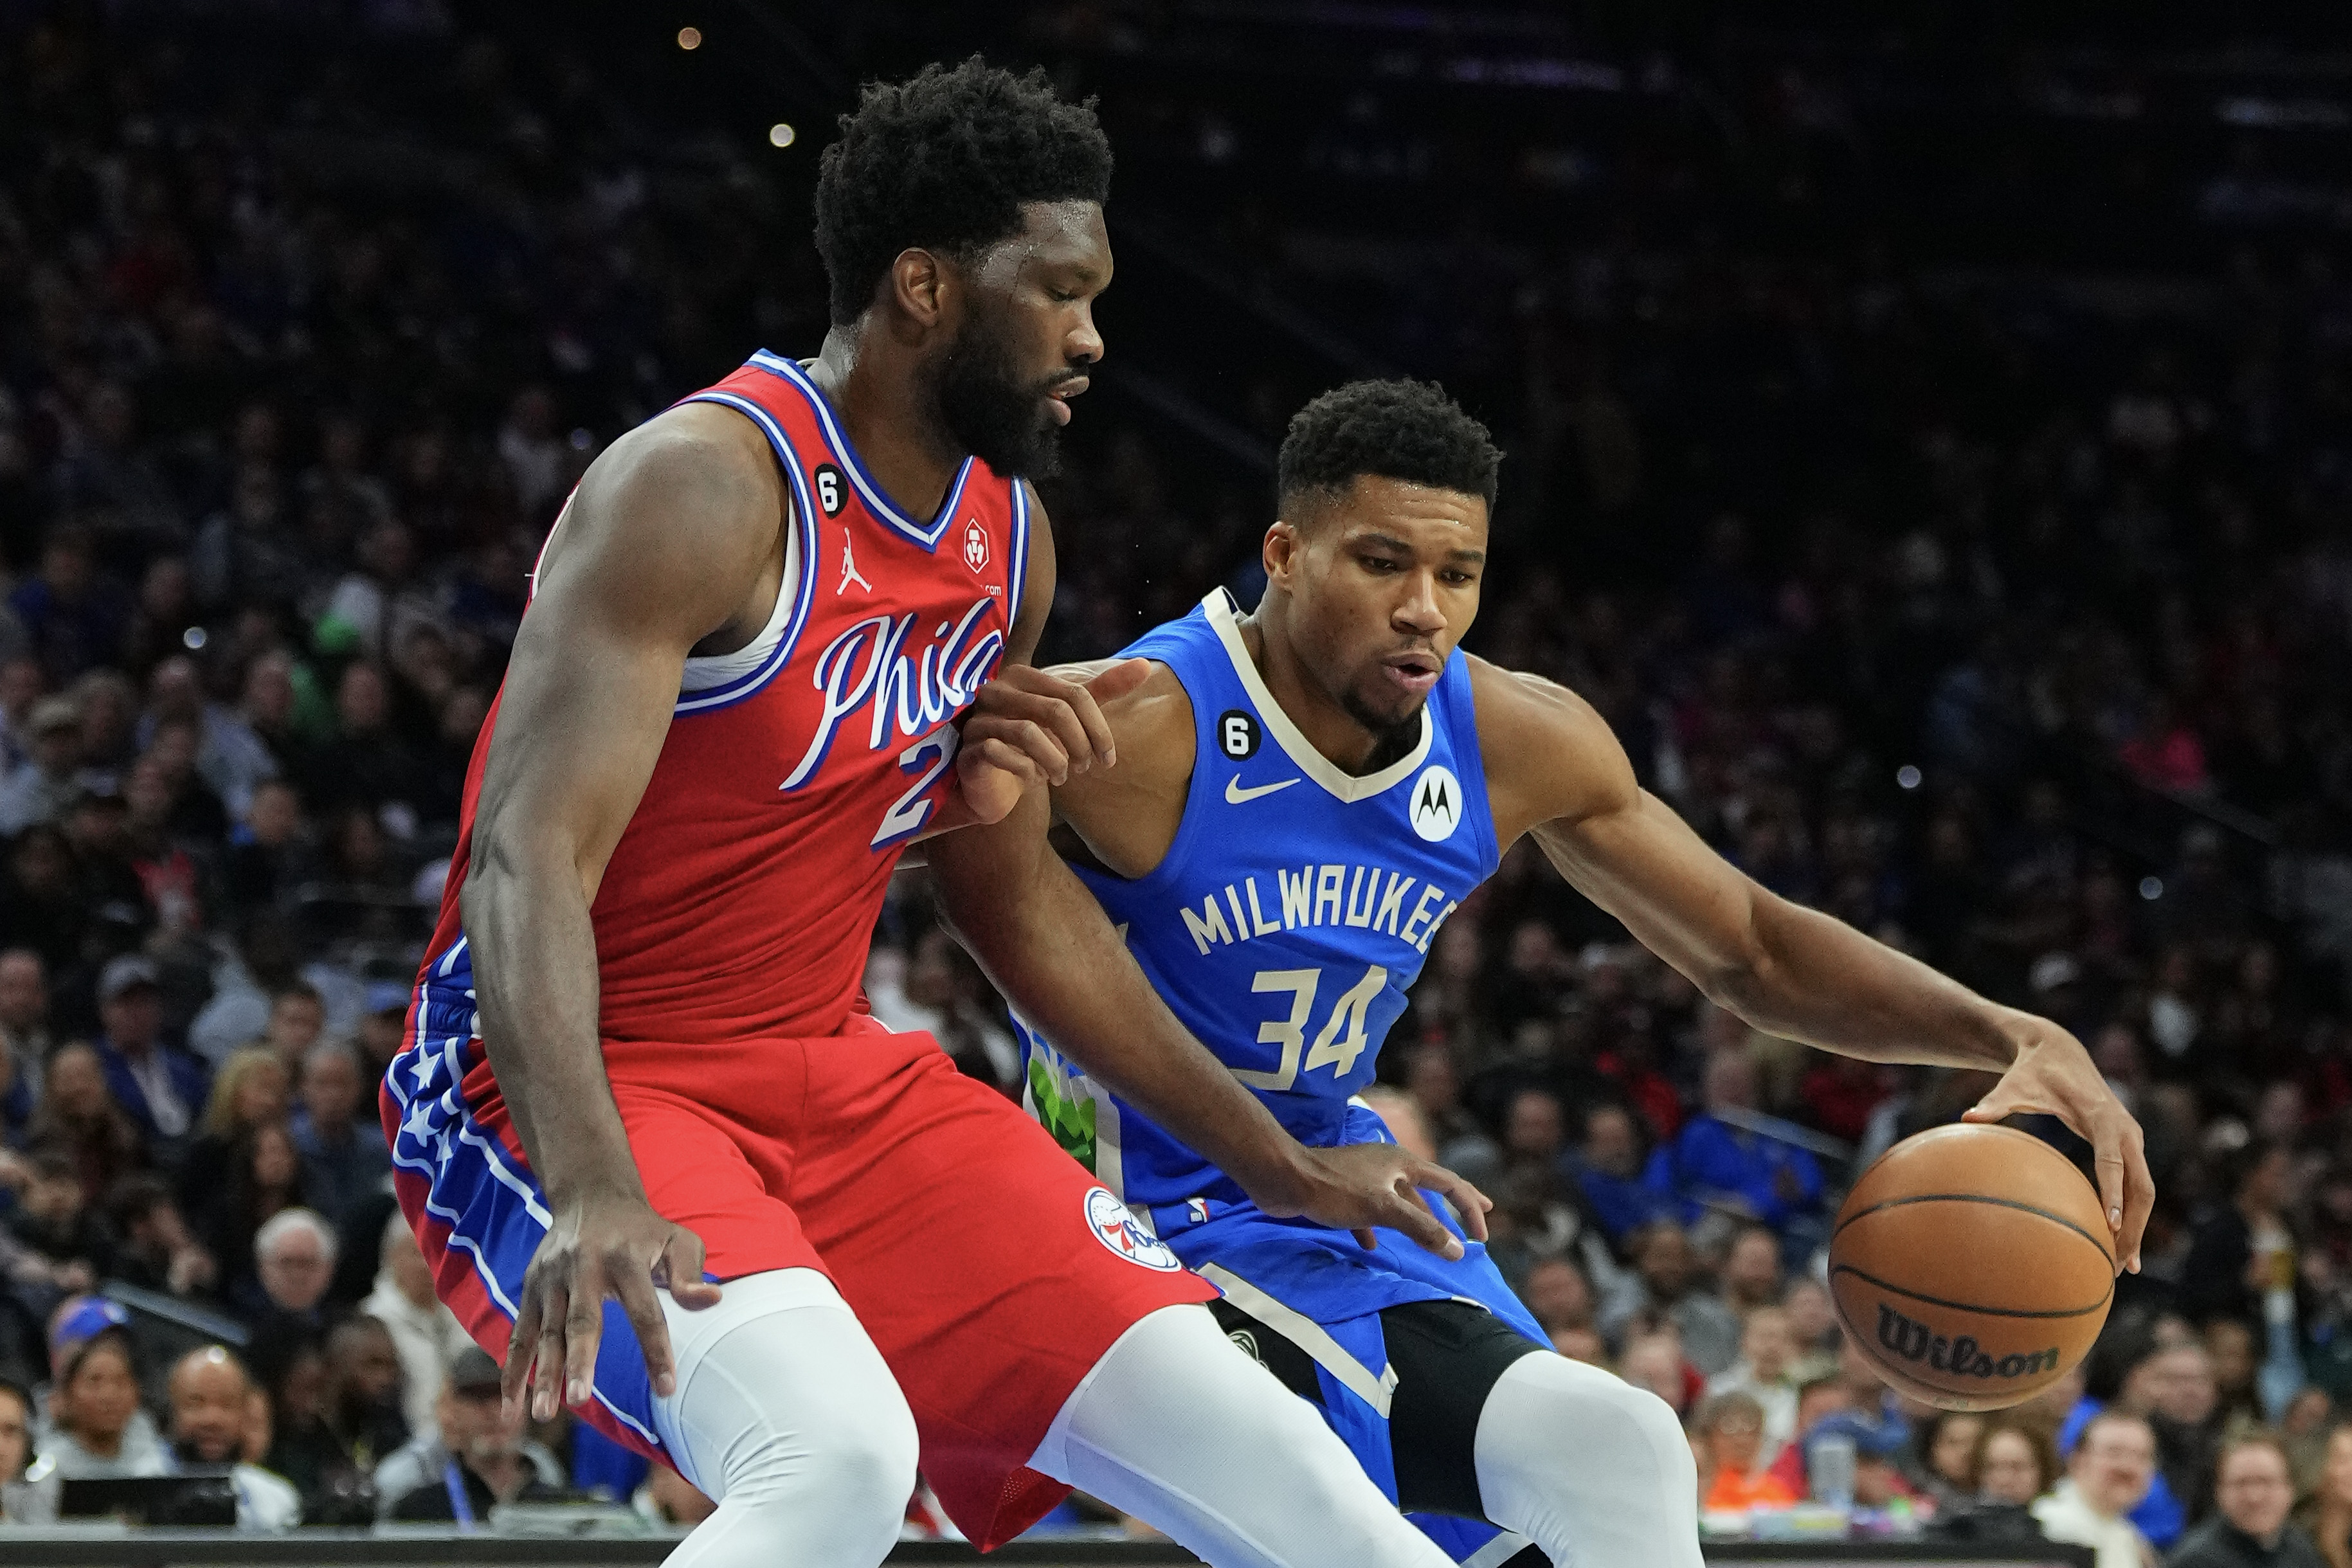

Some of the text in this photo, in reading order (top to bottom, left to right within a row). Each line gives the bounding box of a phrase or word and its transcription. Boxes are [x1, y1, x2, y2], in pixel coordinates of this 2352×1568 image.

[818, 471, 838, 512] 6
[778, 597, 1004, 792] Phila
[1225, 717, 1249, 755] 6
[1226, 965, 1388, 1091] 34
[1878, 1301, 2060, 1378] Wilson
